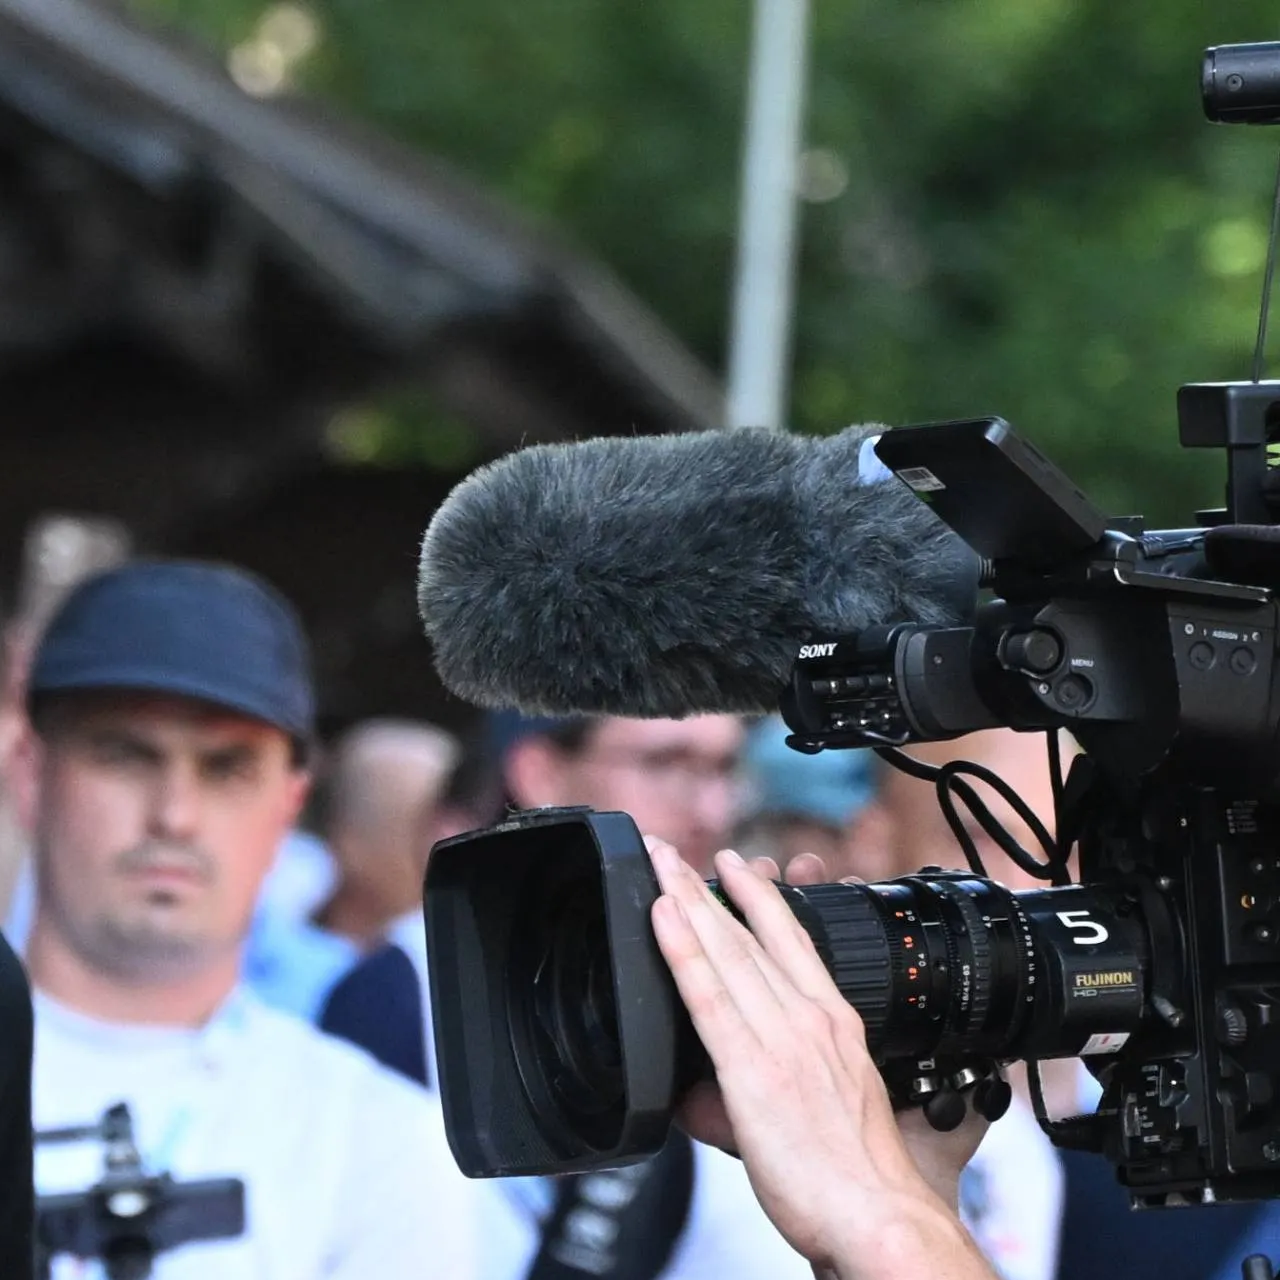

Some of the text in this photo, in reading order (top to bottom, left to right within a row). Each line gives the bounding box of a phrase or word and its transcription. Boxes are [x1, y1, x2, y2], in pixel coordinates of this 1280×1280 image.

[798, 643, 837, 660] SONY
[1055, 910, 1109, 945] 5
[1075, 971, 1133, 987] FUJINON
[1073, 989, 1097, 998] HD
